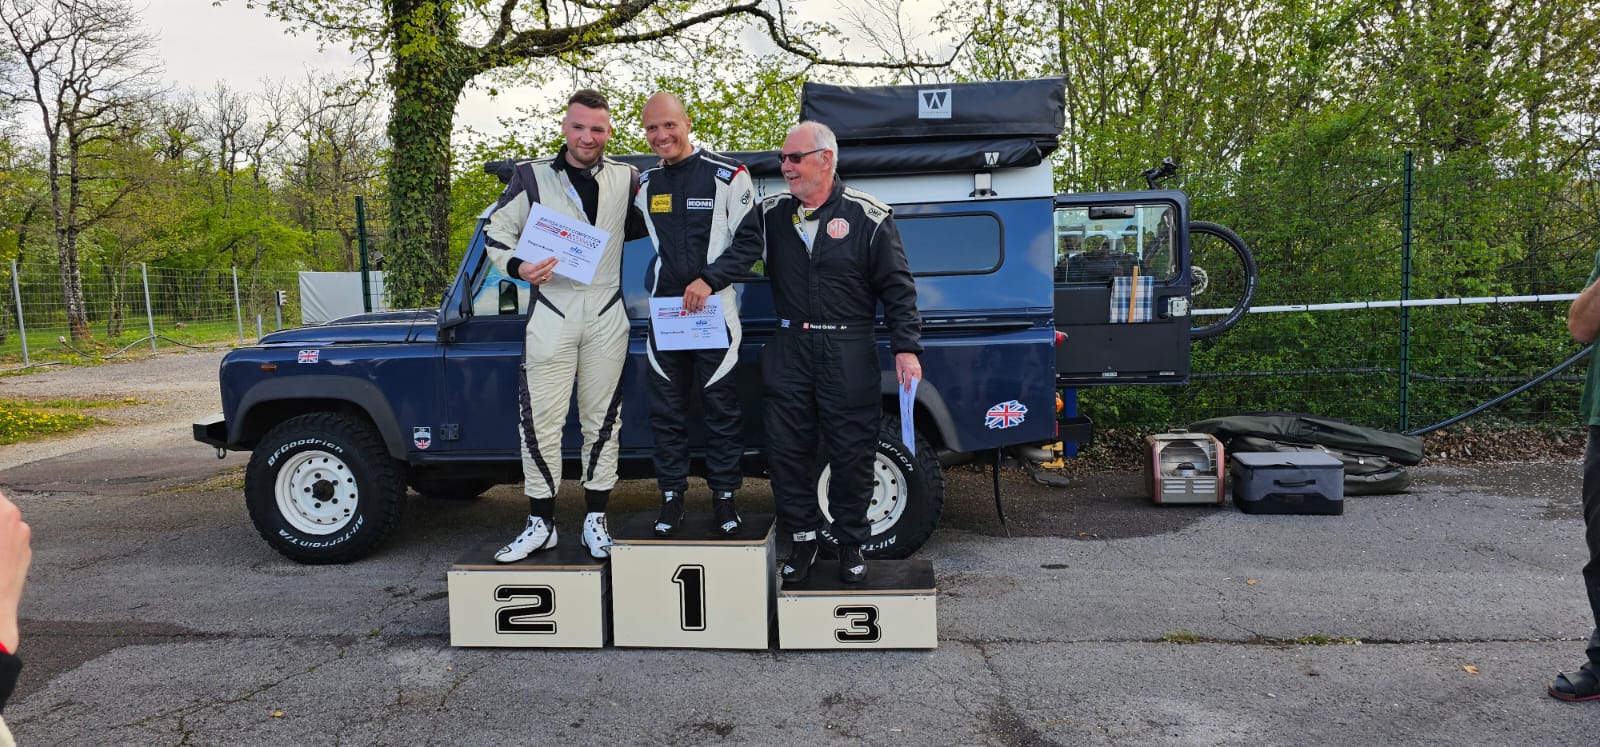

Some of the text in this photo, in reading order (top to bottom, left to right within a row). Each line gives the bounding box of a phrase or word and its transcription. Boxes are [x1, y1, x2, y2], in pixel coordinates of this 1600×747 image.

[687, 200, 712, 208] KONI
[828, 219, 848, 237] MG
[267, 438, 344, 467] BFGoodrich
[279, 514, 363, 548] All-Terrain T/A
[494, 584, 557, 635] 2
[671, 563, 706, 631] 1
[833, 604, 882, 643] 3
